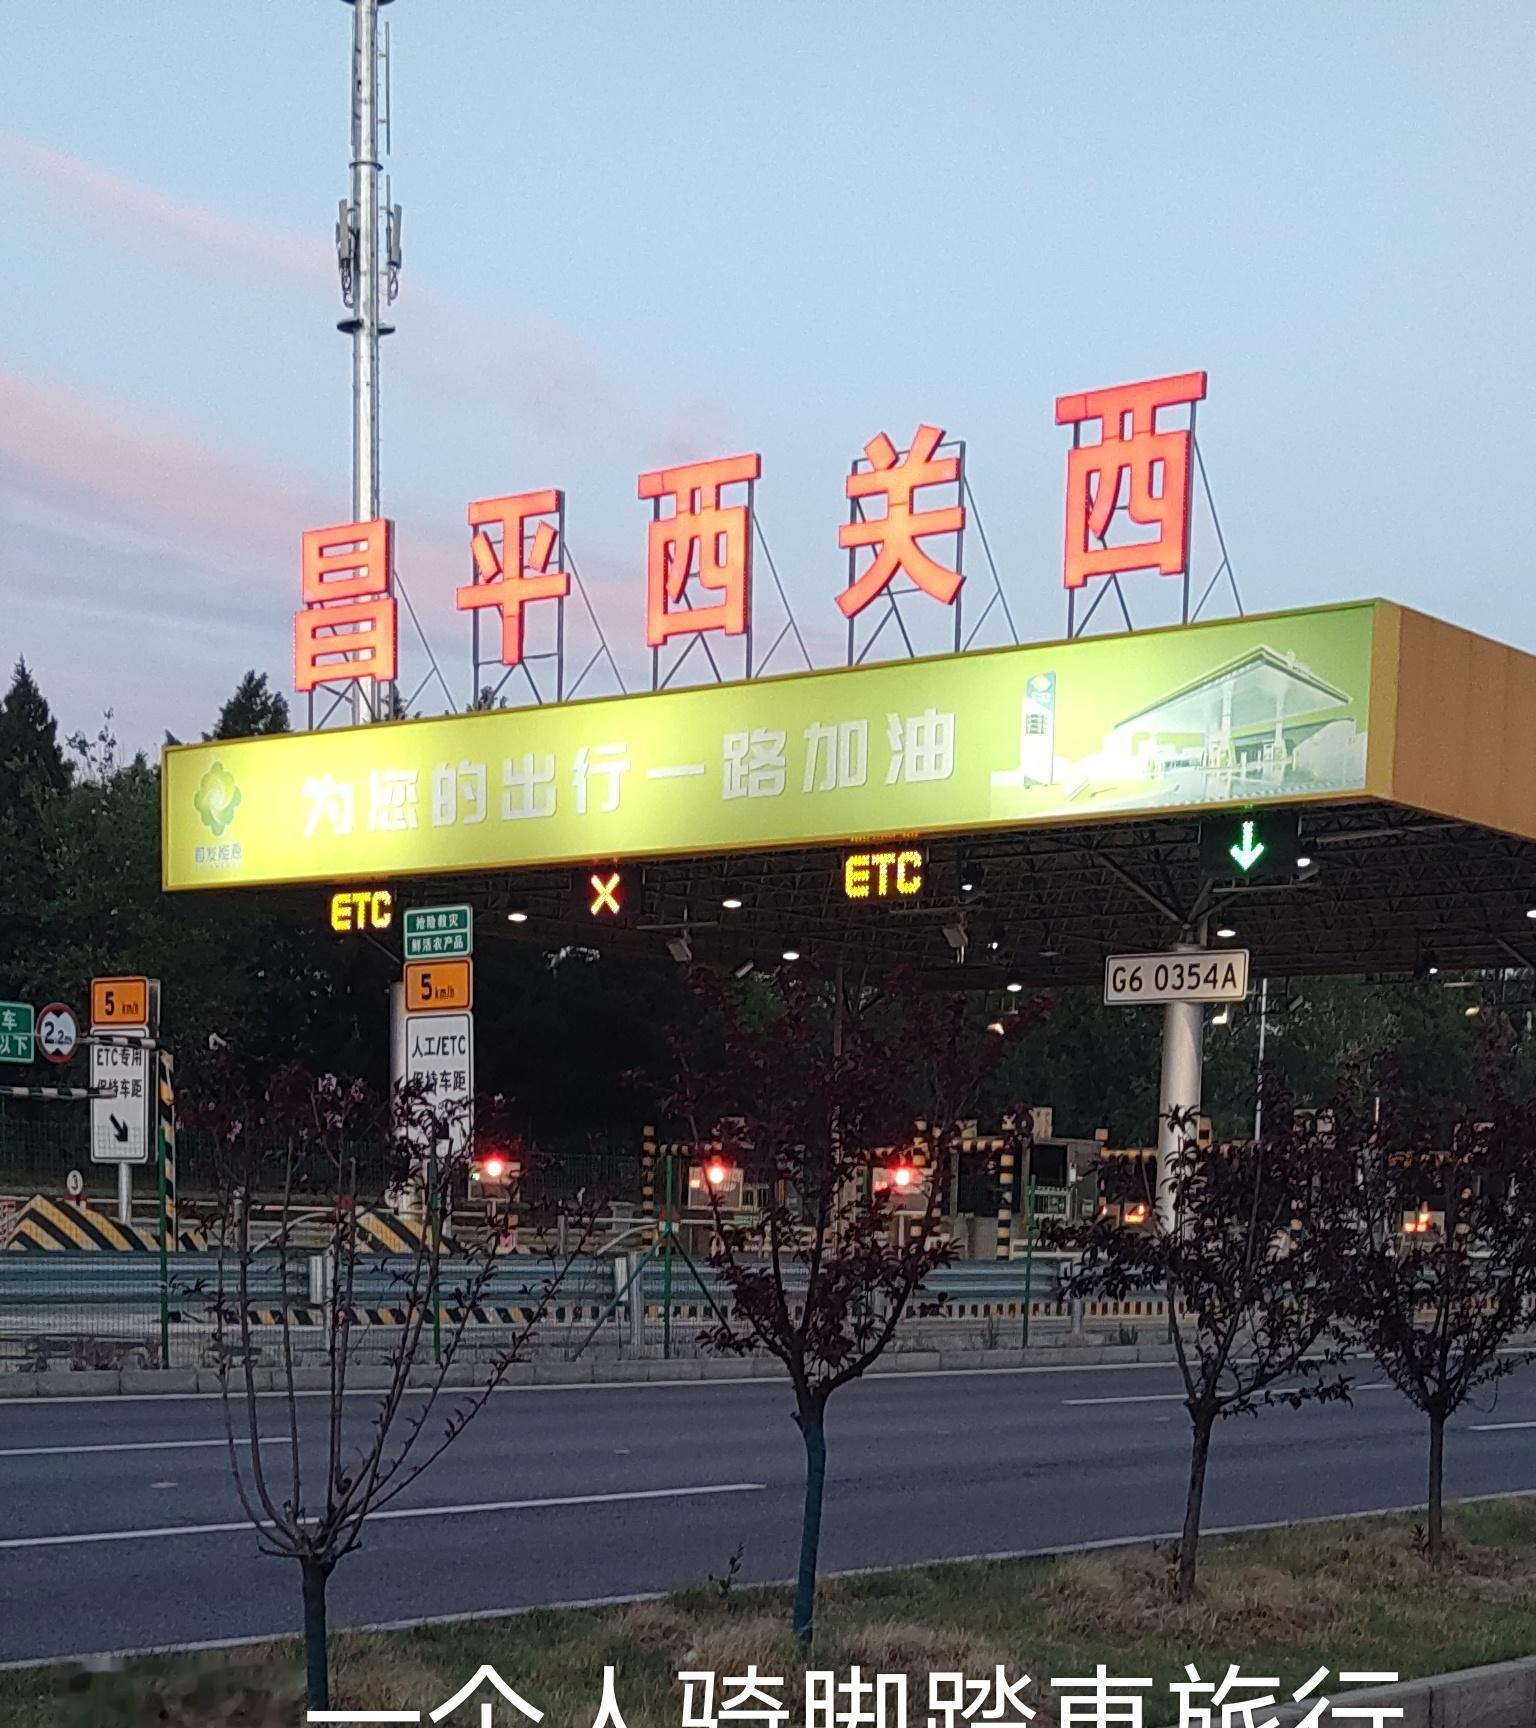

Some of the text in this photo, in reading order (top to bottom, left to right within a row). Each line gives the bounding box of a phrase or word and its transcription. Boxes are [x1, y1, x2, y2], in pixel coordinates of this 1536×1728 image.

[294, 371, 1207, 692] 昌平西关西
[301, 709, 958, 838] 为您的出行一路加油
[844, 851, 923, 898] ETC
[331, 891, 392, 931] ETC
[1112, 963, 1238, 992] G6 0354A
[104, 992, 115, 1016] 5
[96, 1048, 143, 1067] ETC专用
[411, 1035, 467, 1058] 人工/ETC
